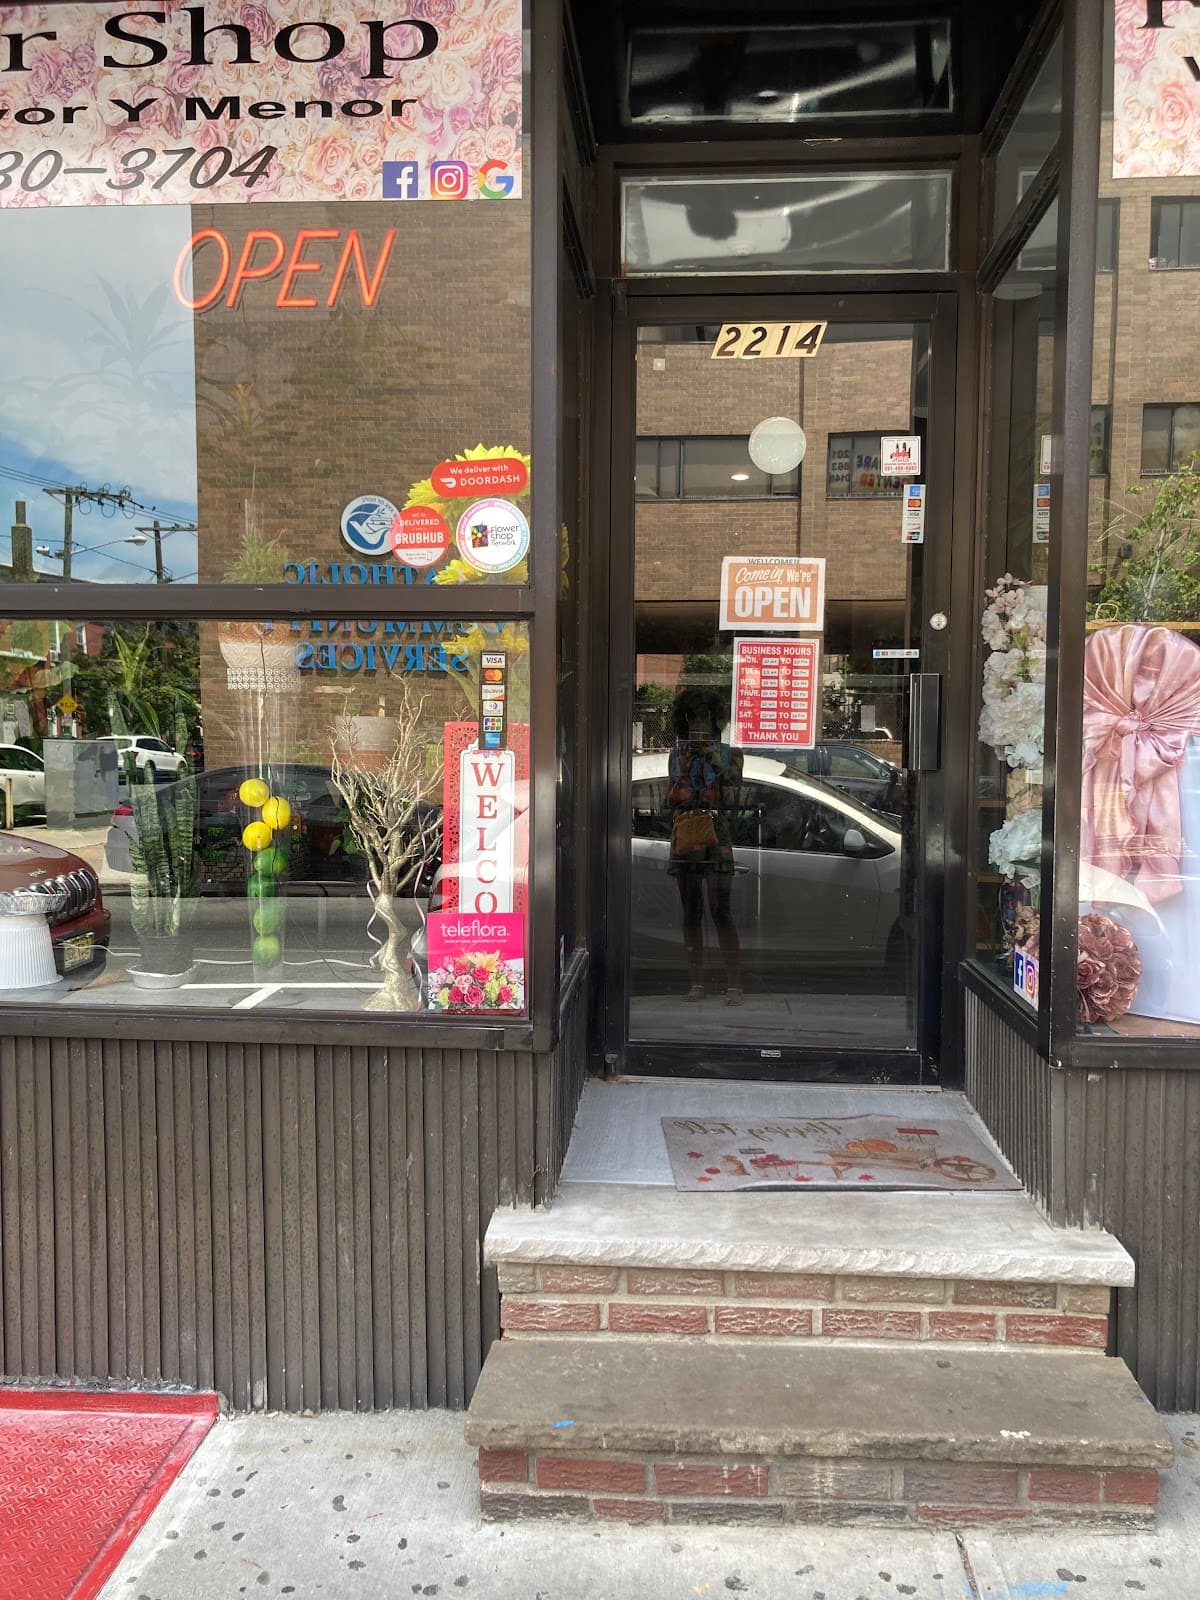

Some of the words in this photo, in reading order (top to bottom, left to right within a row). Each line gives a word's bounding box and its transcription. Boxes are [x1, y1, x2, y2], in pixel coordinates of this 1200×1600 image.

[103, 5, 440, 80] Shop
[0, 103, 89, 126] or
[109, 98, 160, 123] Y
[185, 95, 418, 121] Menor
[173, 228, 396, 311] OPEN
[715, 324, 823, 358] 2214
[449, 466, 463, 475] We
[464, 464, 491, 475] deliver
[491, 463, 509, 473] with
[460, 474, 521, 487] DOORDASH
[399, 519, 440, 528] DELIVERED
[395, 532, 445, 545] GRUBHUB
[735, 567, 770, 584] Come
[787, 569, 812, 583] We're
[734, 585, 811, 618] OPEN
[741, 646, 781, 655] BUSINESS
[783, 647, 812, 656] HOURS
[778, 722, 789, 730] TO
[748, 731, 778, 740] THANK
[780, 732, 799, 741] YOU
